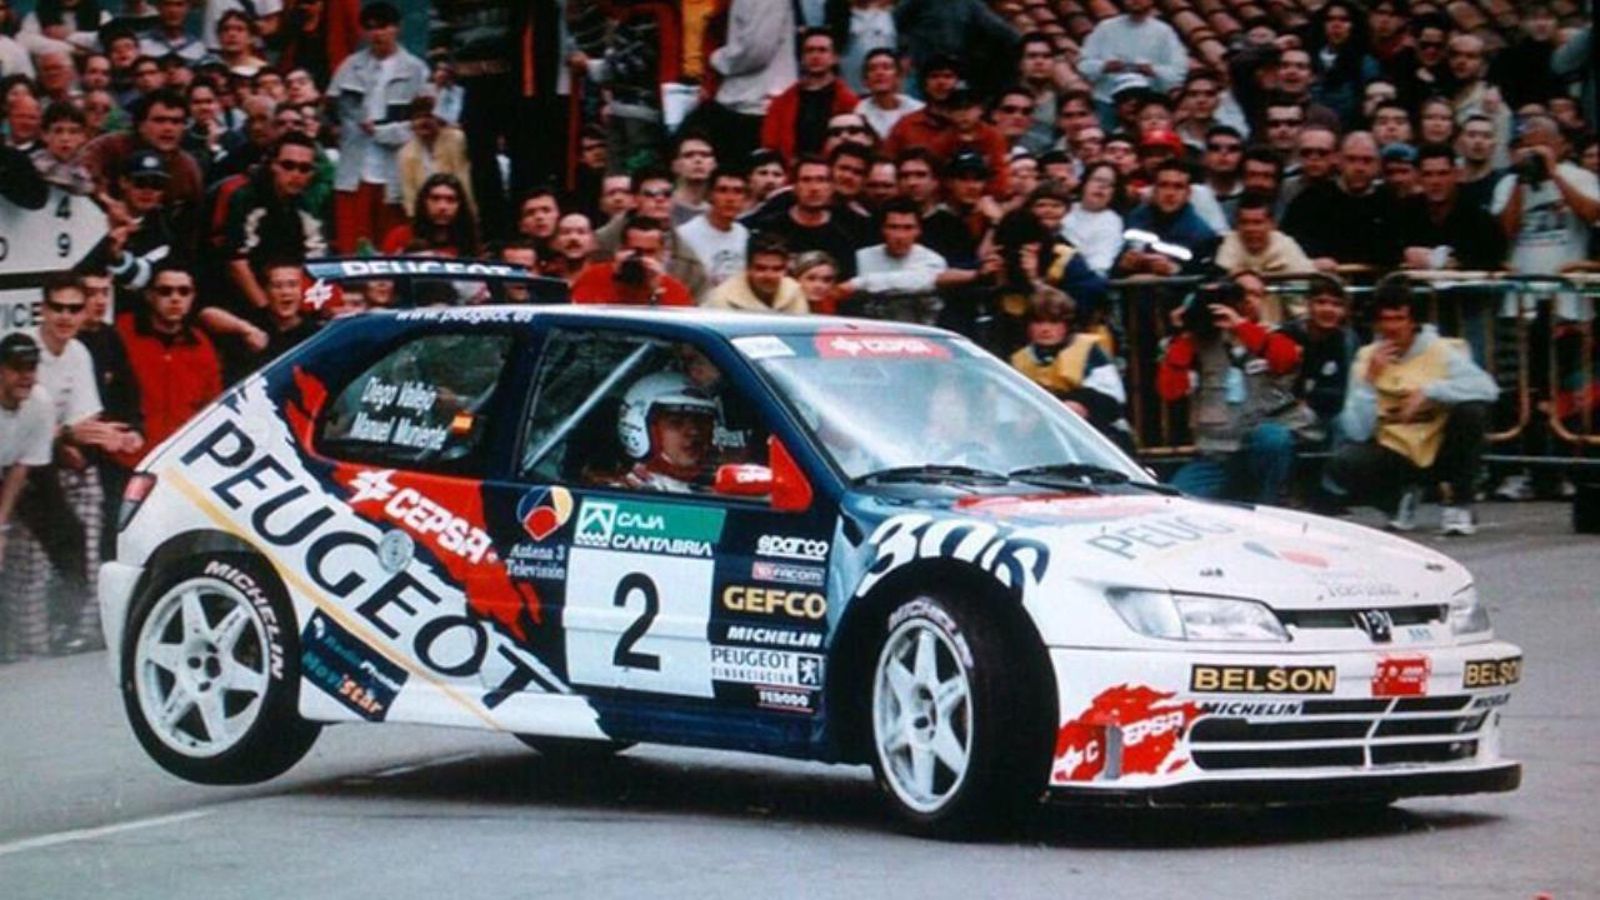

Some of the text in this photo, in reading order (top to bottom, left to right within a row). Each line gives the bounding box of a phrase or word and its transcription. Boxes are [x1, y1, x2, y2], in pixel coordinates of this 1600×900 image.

[55, 195, 71, 219] 4
[57, 233, 70, 257] 9
[384, 487, 492, 563] CEPSA
[617, 513, 665, 530] CAJA
[555, 544, 565, 560] 3
[612, 533, 713, 556] CANTABRIA
[757, 534, 829, 558] sparco
[180, 419, 563, 710] PEUGEOT
[723, 585, 827, 619] GEFCO
[204, 560, 284, 680] MICHELIN
[613, 571, 661, 672] 2
[727, 625, 822, 648] MICHELIN
[711, 647, 790, 669] PEUGEOT
[1194, 667, 1335, 692] BELSON
[1199, 702, 1303, 716] MICHELIN
